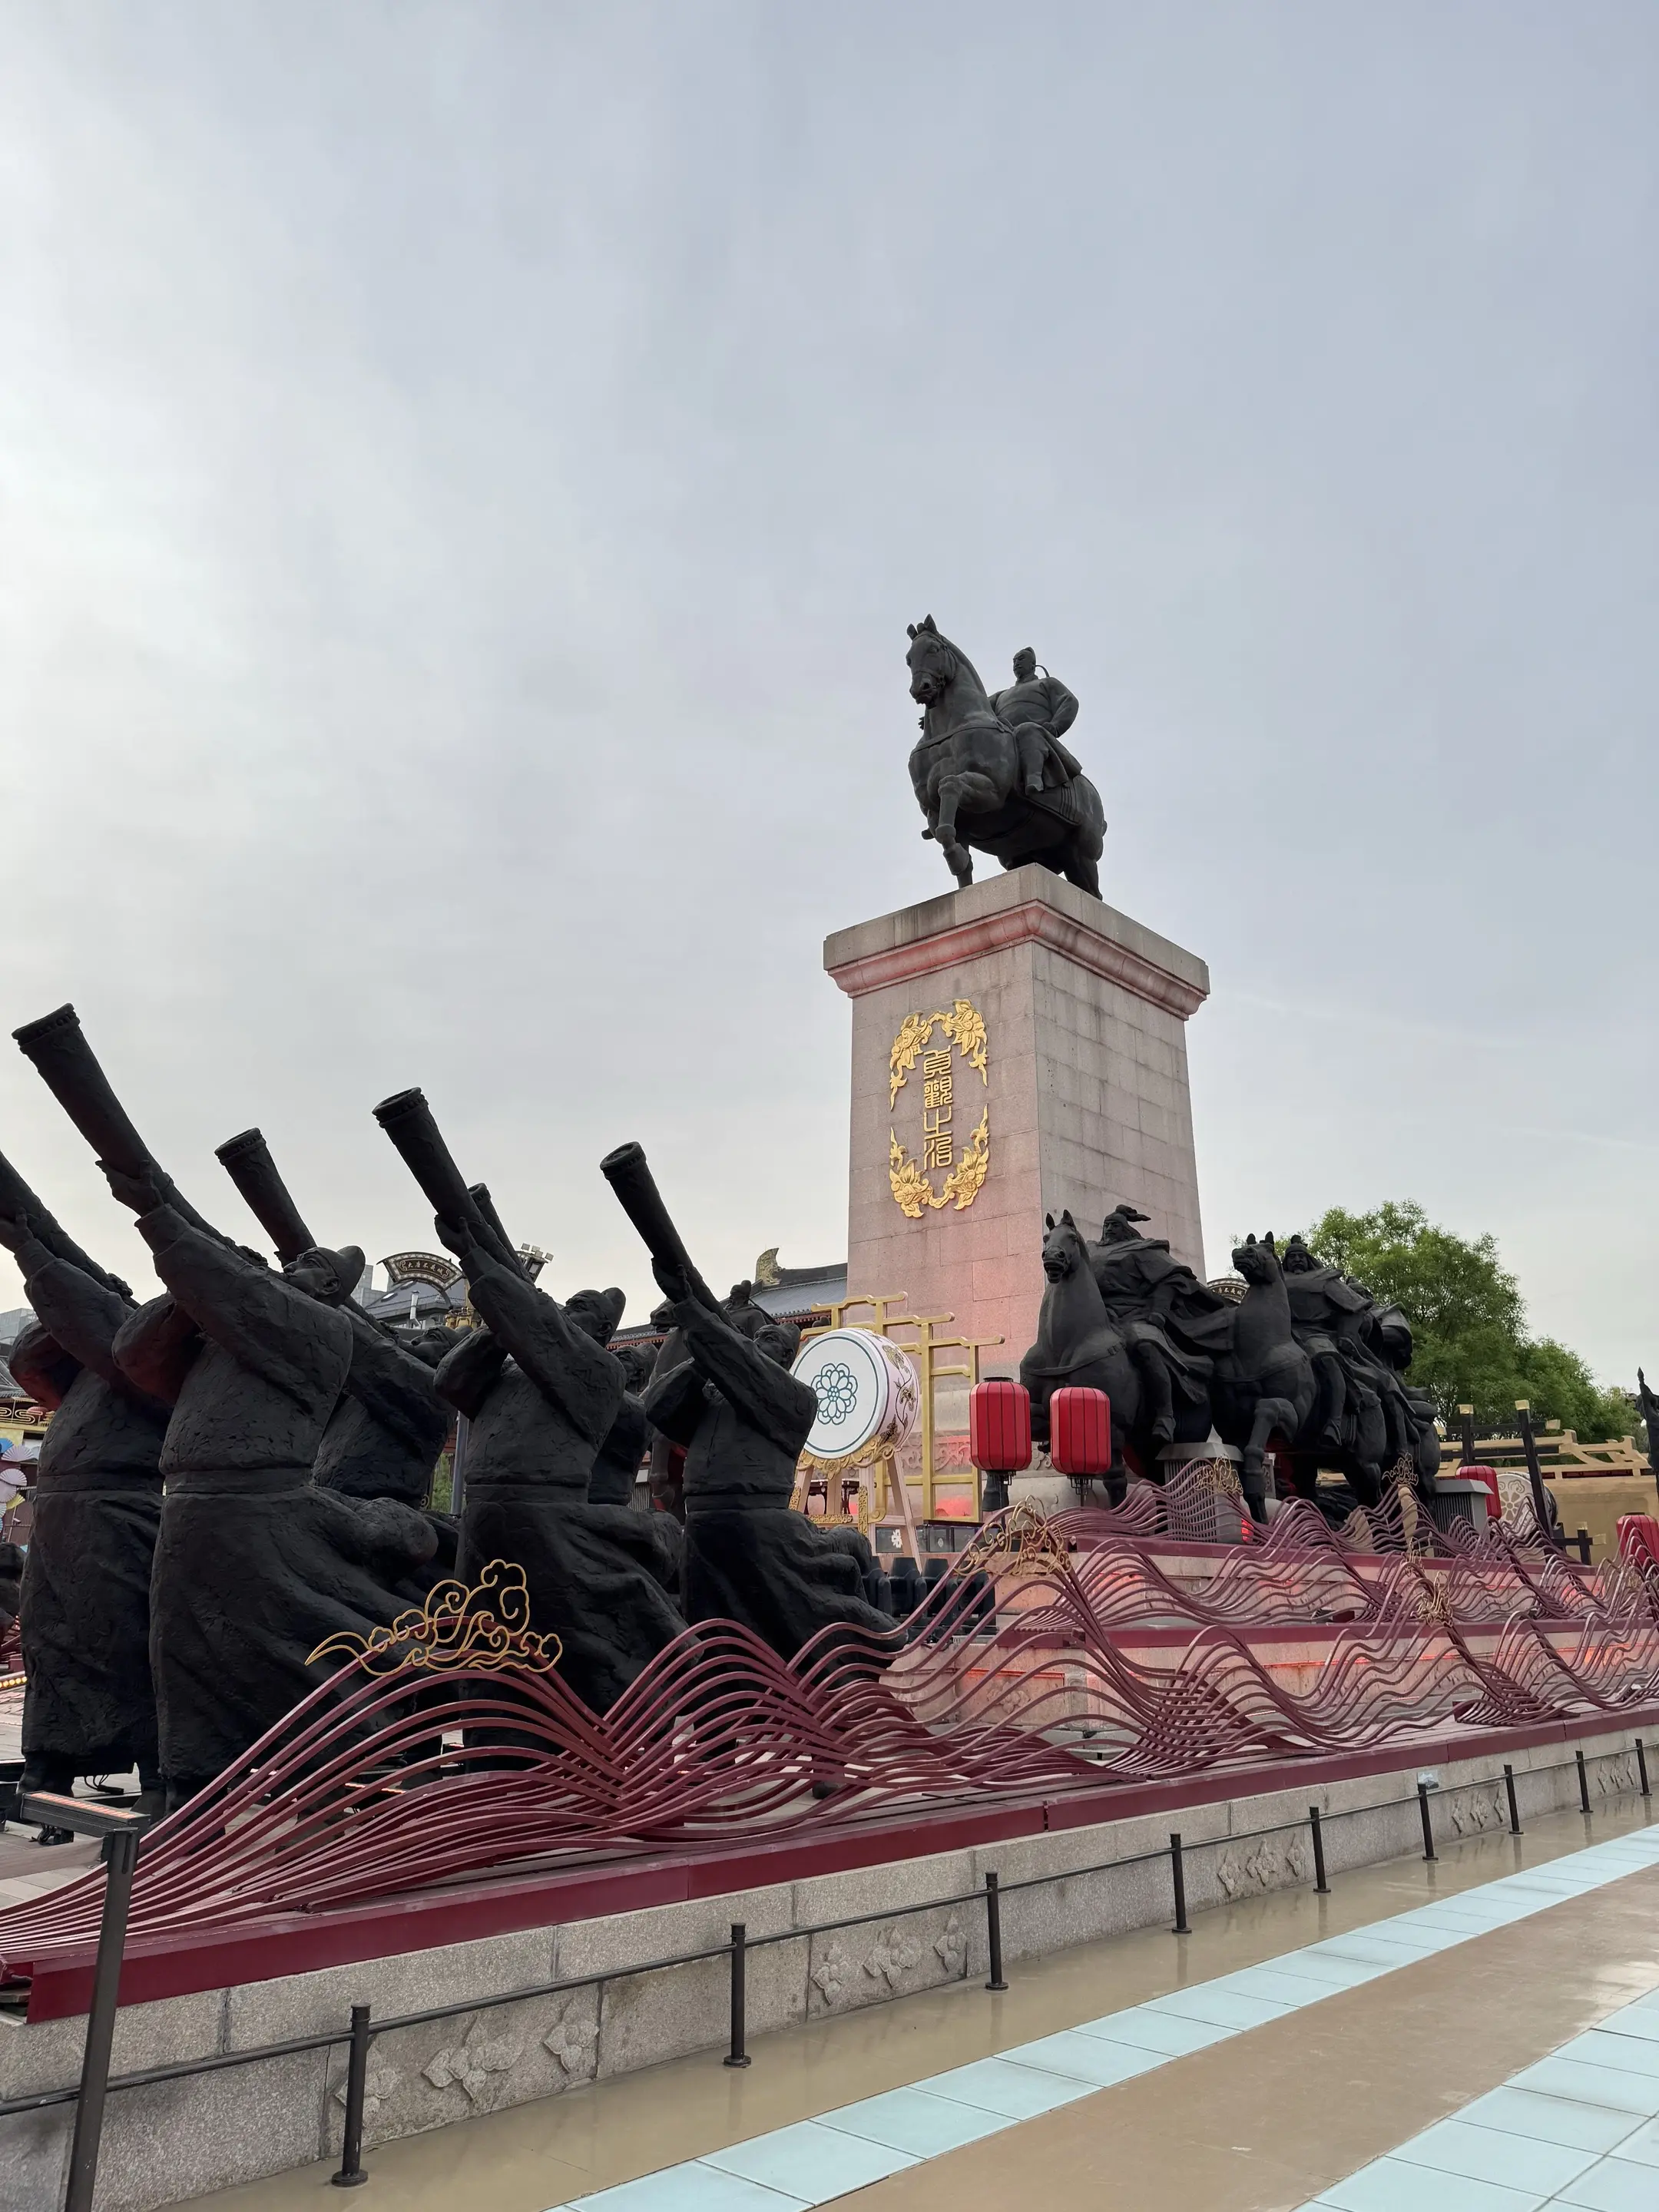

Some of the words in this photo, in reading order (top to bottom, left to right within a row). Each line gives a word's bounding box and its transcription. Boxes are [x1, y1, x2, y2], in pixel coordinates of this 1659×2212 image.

[407, 1260, 444, 1275] 大唐不夜城
[1213, 1286, 1243, 1296] 唐不夜城
